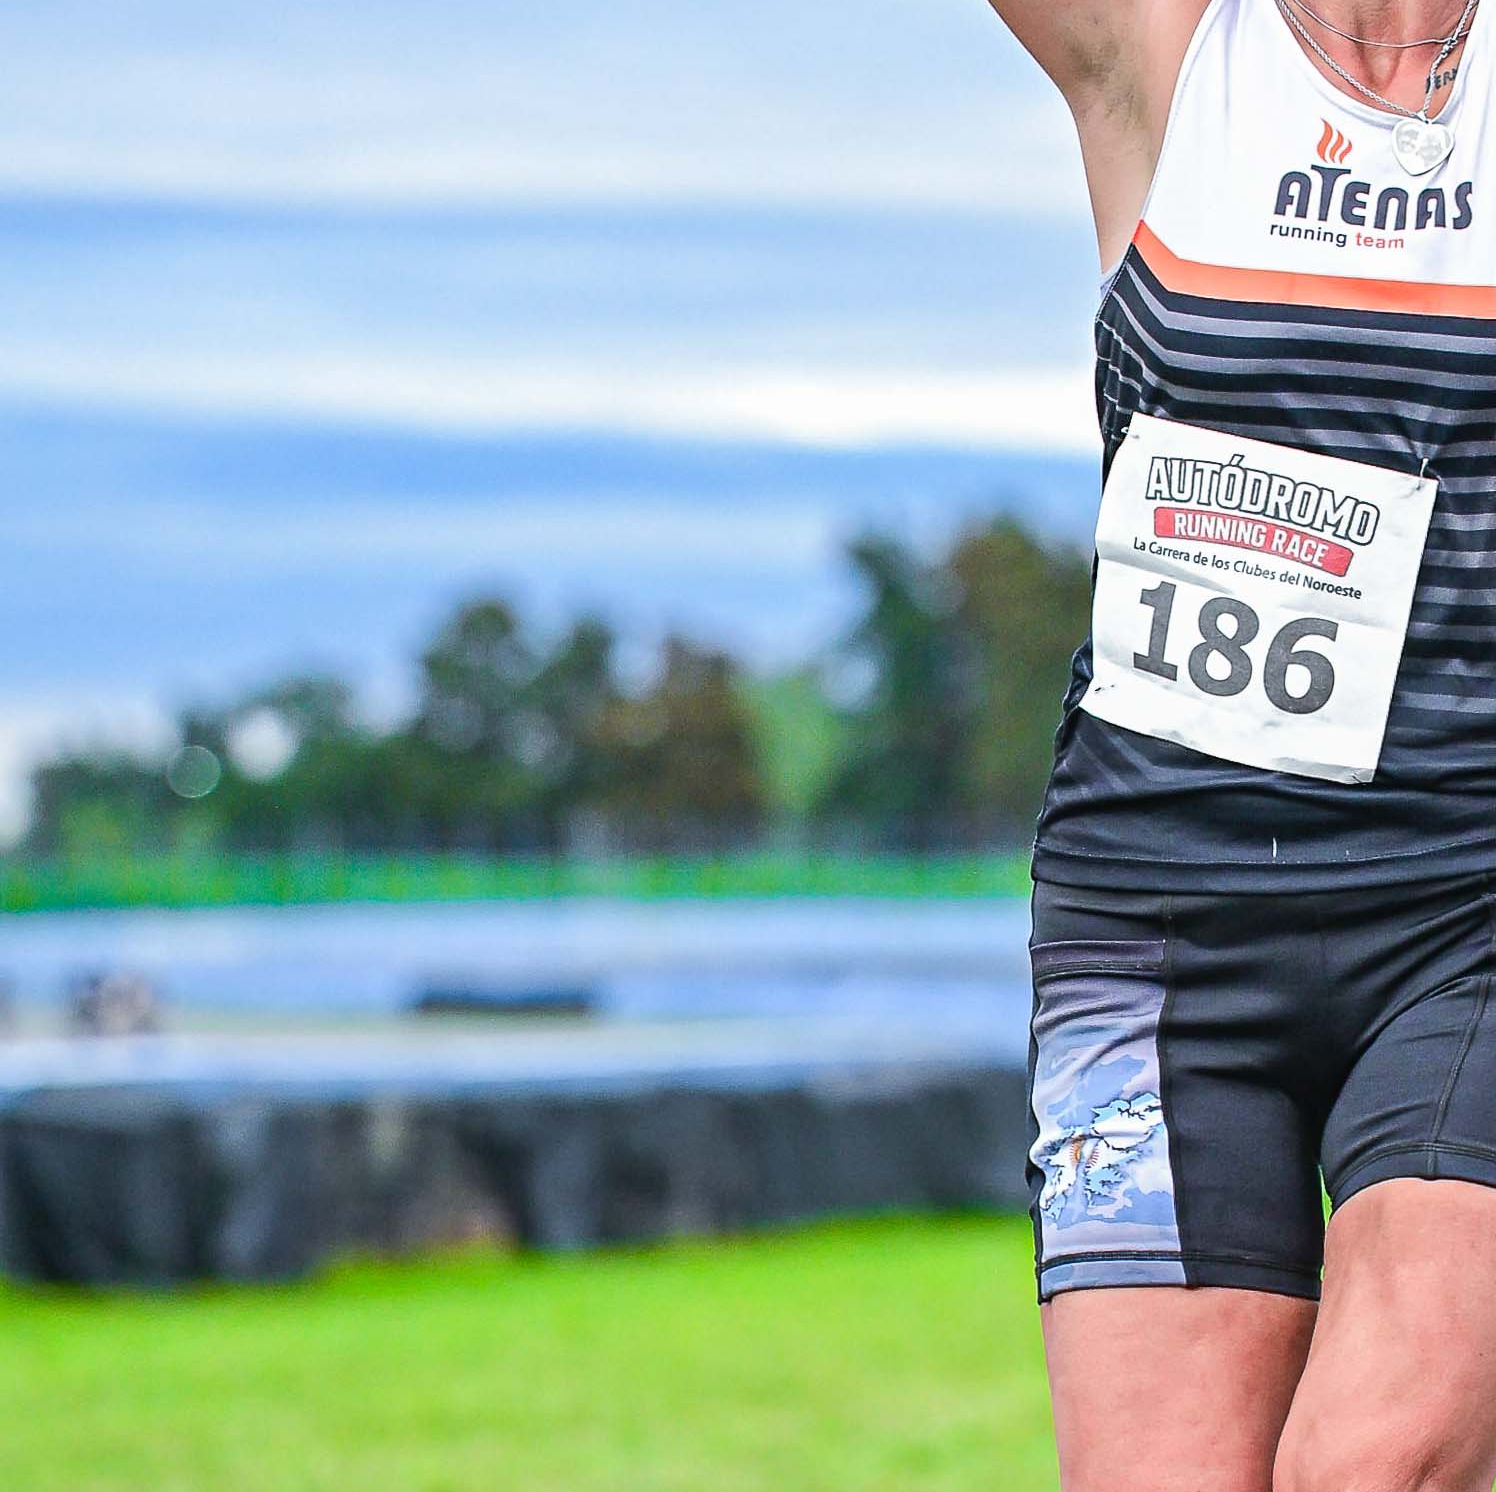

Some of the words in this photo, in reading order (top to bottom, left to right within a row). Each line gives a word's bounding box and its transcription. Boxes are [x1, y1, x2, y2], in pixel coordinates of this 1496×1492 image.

[1273, 164, 1473, 230] ATENAS
[1269, 222, 1348, 248] running
[1355, 231, 1404, 249] team
[1145, 454, 1381, 546] AUTÓDROMO
[1133, 536, 1146, 551] La
[1149, 541, 1190, 562] Carrera
[1193, 549, 1209, 565] de
[1211, 554, 1230, 570] los
[1233, 560, 1276, 581] Clubes
[1279, 570, 1301, 586] del
[1303, 576, 1362, 600] Noroeste
[1173, 512, 1268, 548] RUNNING
[1271, 524, 1330, 568] RACE
[1133, 580, 1339, 714] 186
